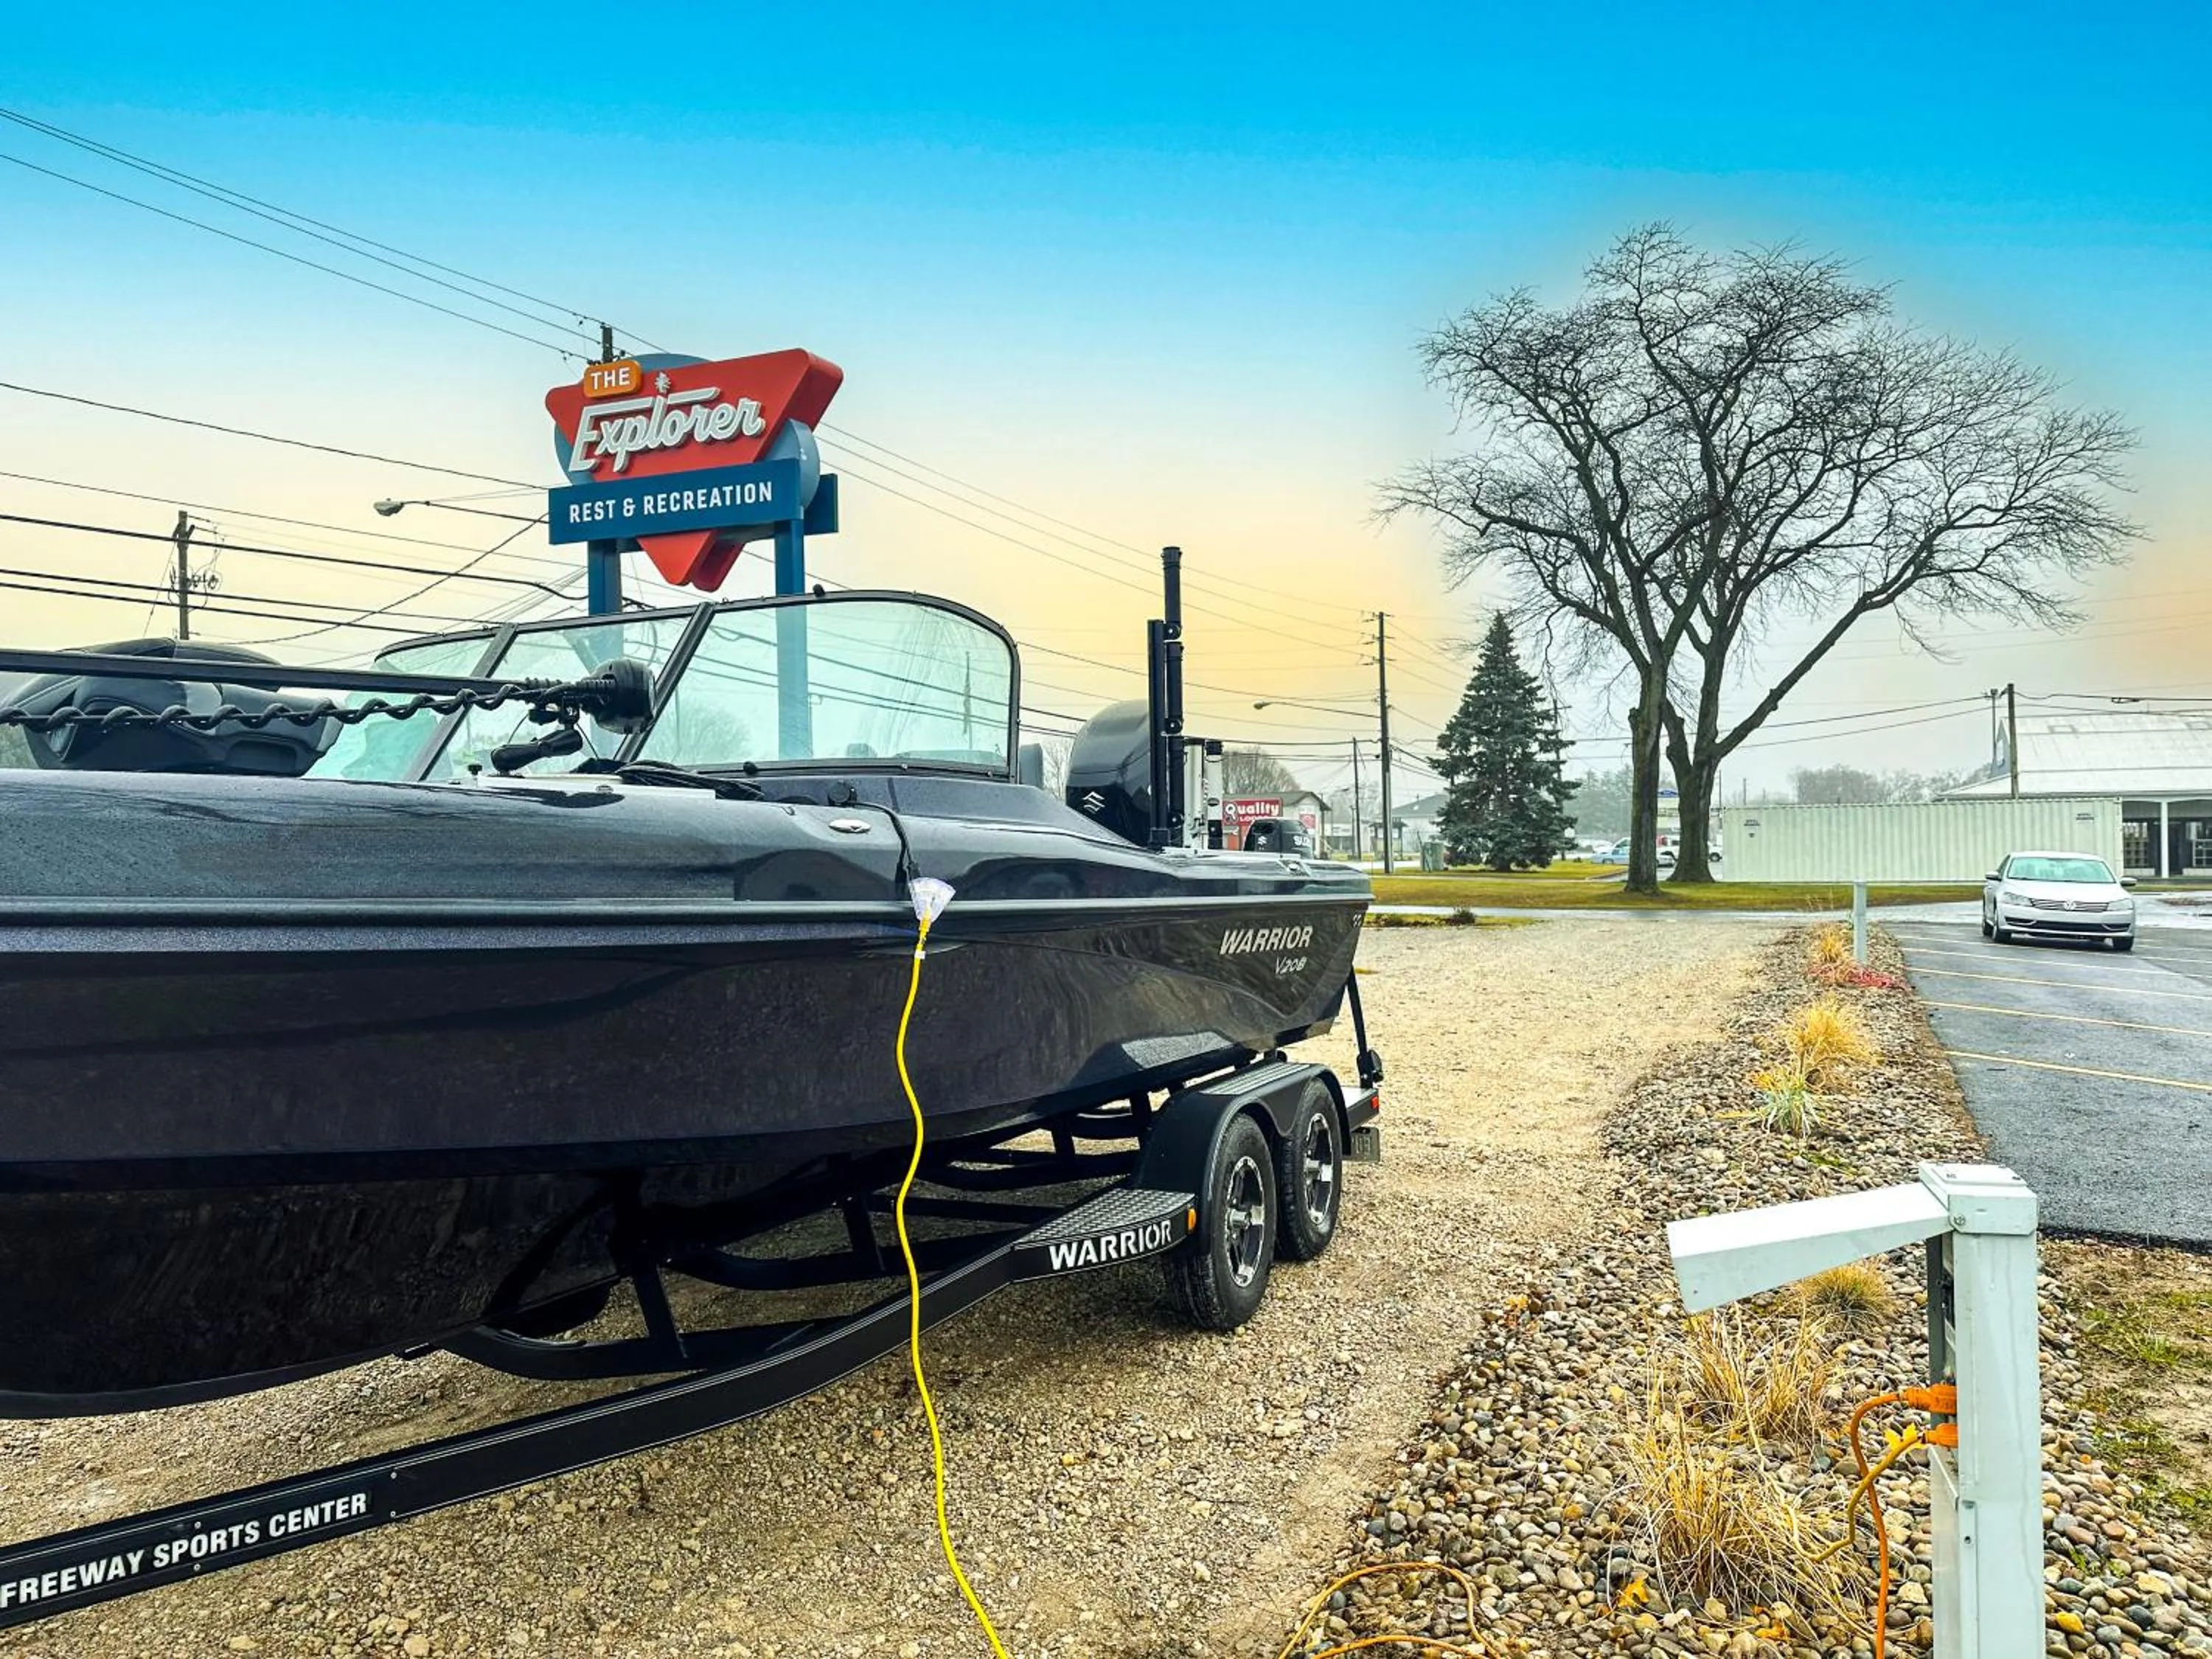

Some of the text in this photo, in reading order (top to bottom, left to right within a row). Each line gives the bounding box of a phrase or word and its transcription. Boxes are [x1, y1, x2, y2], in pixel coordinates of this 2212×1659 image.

[590, 367, 631, 390] THE
[568, 386, 766, 472] Explorer
[569, 481, 773, 524] REST & RECREATION
[1225, 801, 1280, 820] Quality
[1219, 925, 1314, 956] WARRIOR
[1048, 1219, 1172, 1271] WARRIOR
[0, 1492, 367, 1609] FREEWAY SPORTS CENTER
